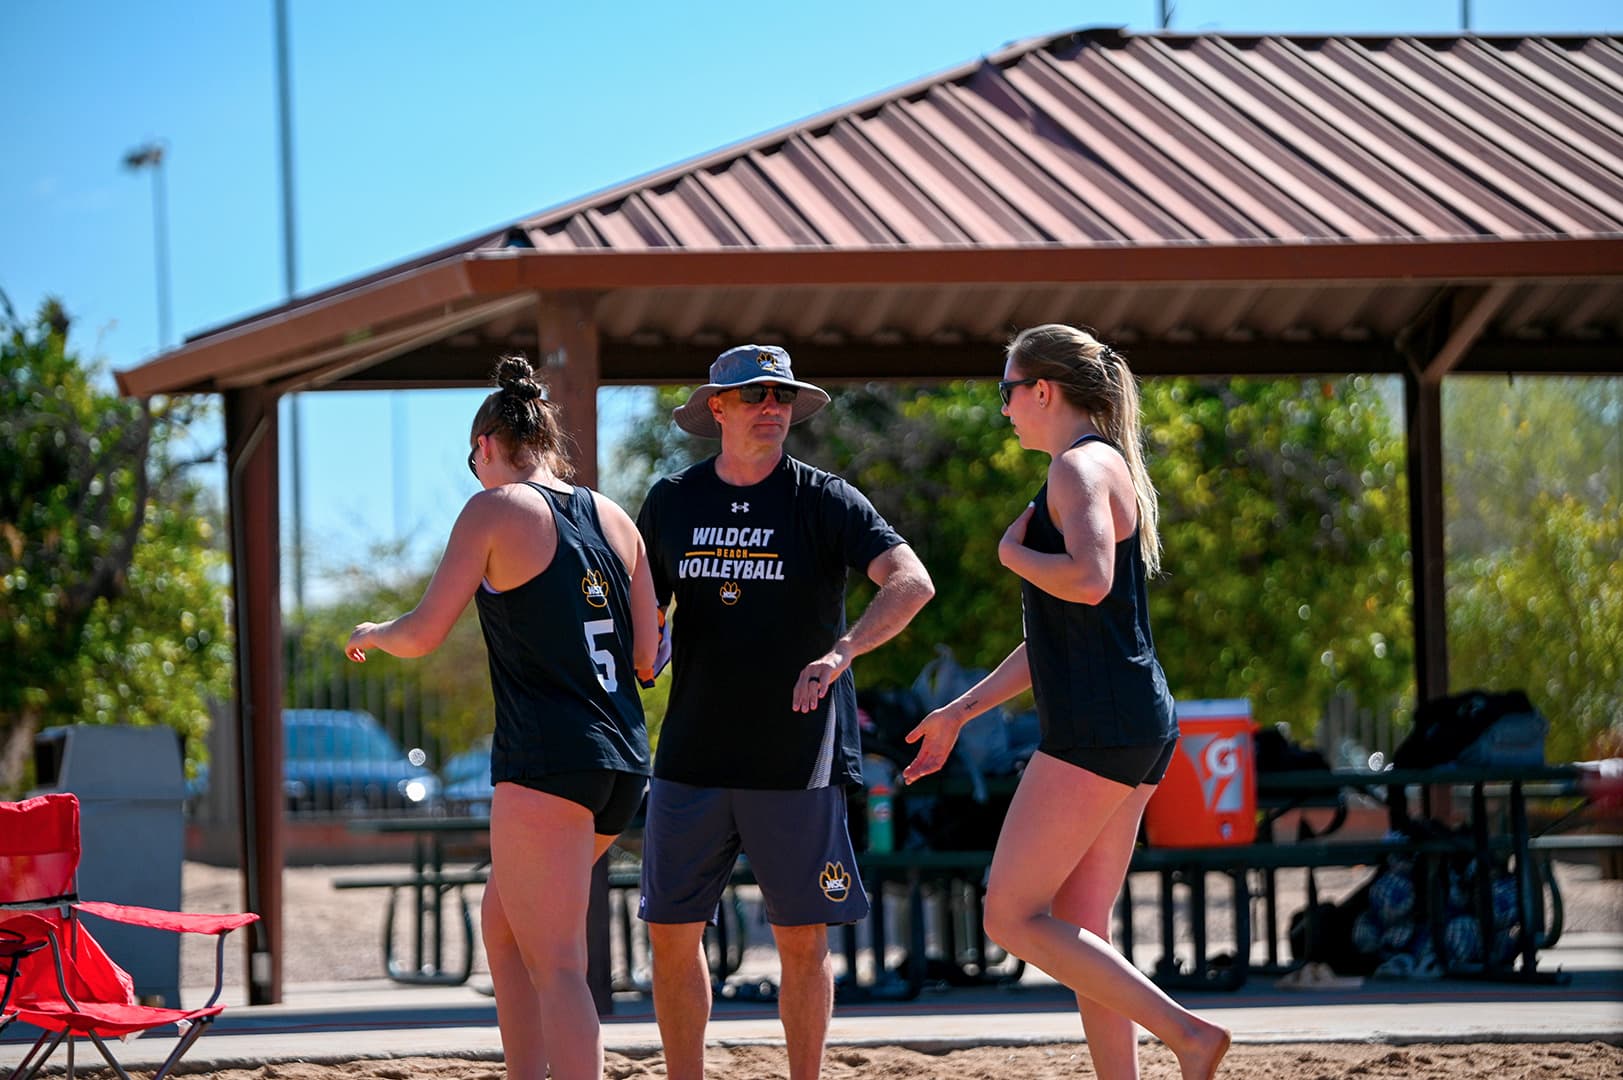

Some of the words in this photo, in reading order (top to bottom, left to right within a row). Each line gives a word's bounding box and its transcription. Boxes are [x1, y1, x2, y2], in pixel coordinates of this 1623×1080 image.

[692, 527, 774, 547] WILDCAT
[716, 548, 748, 558] BEACH
[678, 558, 785, 580] VOLLEYBALL
[583, 618, 618, 693] 5
[1205, 738, 1239, 777] G
